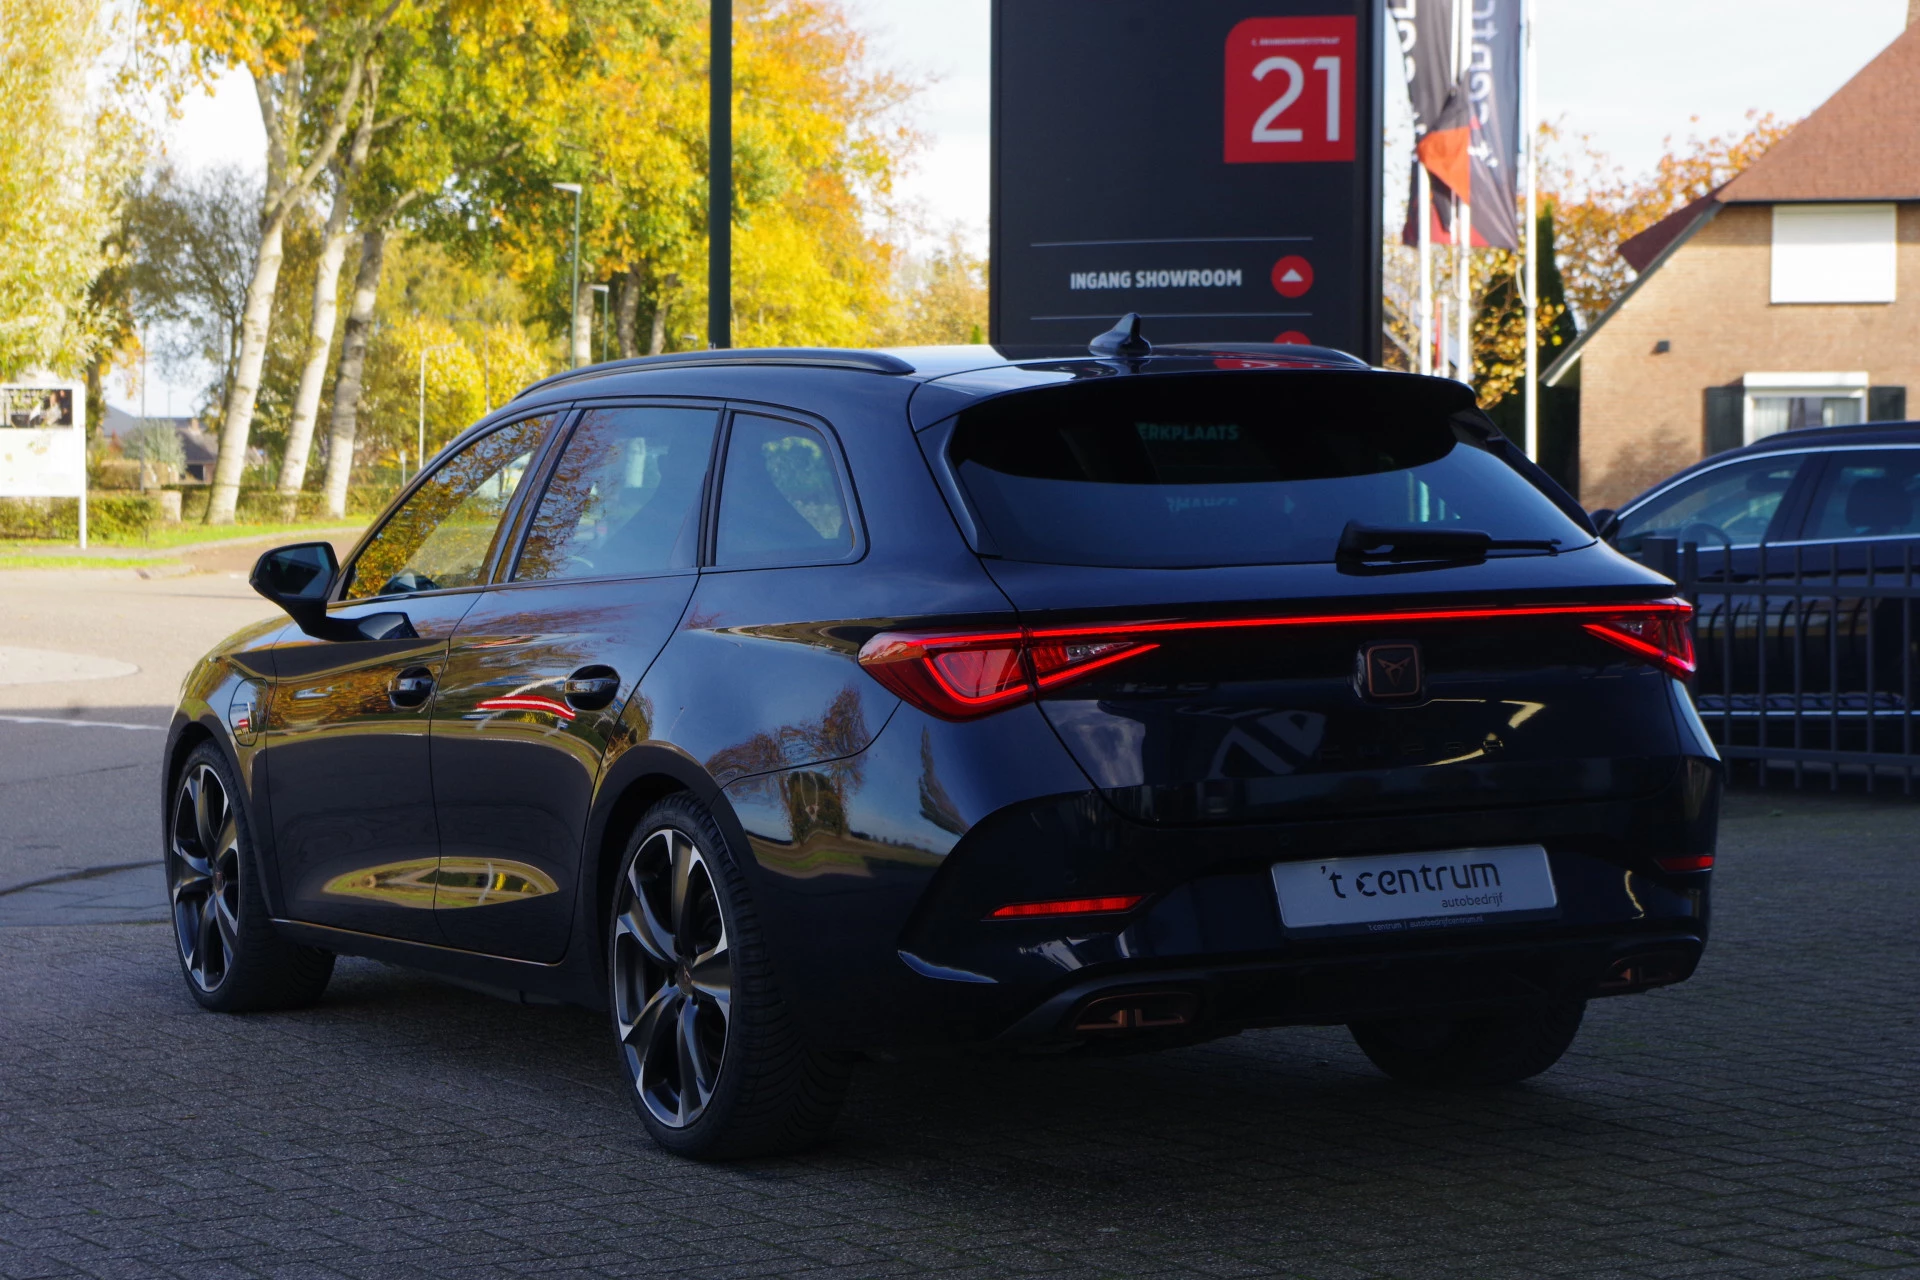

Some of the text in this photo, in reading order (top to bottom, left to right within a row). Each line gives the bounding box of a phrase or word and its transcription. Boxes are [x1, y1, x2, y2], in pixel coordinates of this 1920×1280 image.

[1252, 56, 1341, 142] 21
[1071, 269, 1242, 290] INGANG SHOWROOM
[1321, 863, 1501, 898] 't centrum
[1441, 892, 1503, 908] autobedrijf
